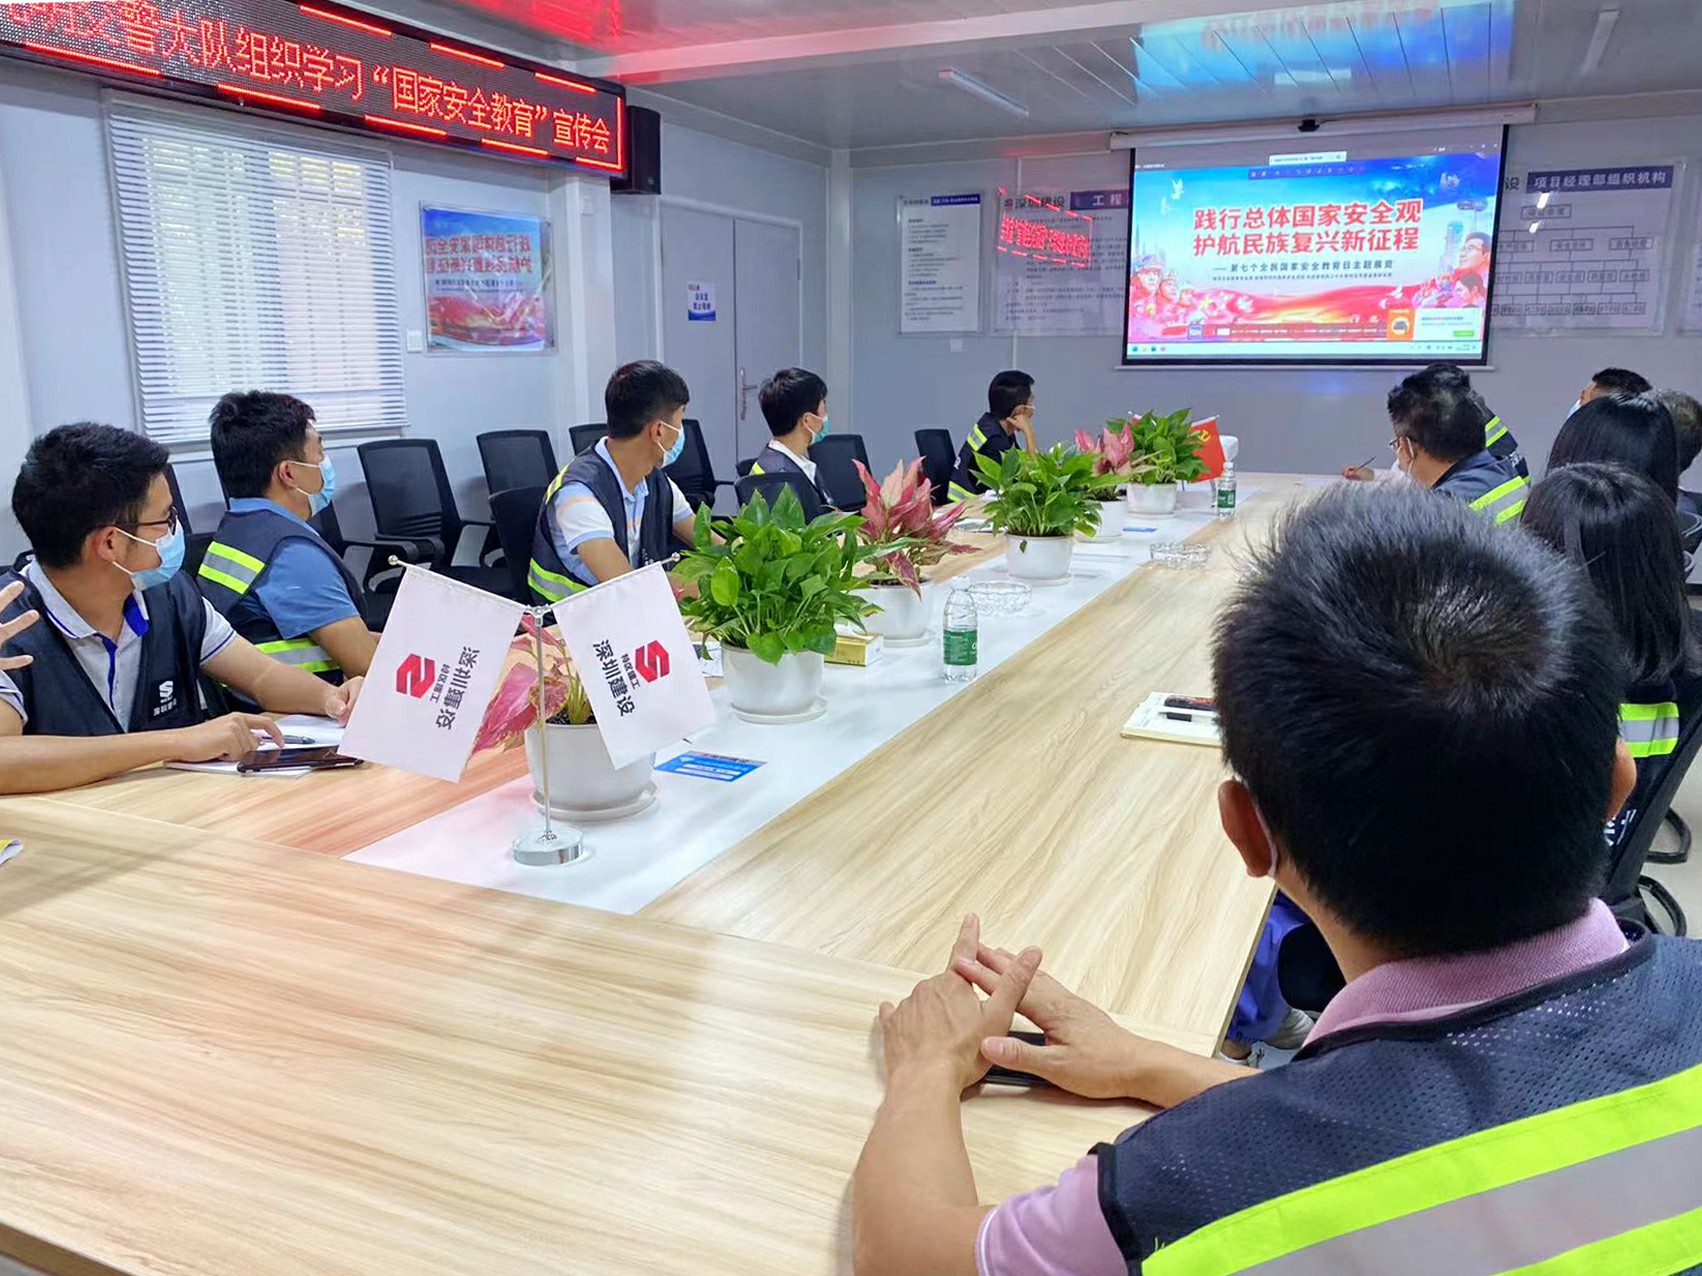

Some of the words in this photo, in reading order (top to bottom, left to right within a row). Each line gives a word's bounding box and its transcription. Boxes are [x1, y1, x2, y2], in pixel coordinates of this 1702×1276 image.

[1534, 171, 1666, 188] 项目经理部组织机构
[1194, 200, 1422, 230] 践行总体国家安全观
[1193, 227, 1420, 256] 护航民族复兴新征程
[593, 639, 635, 717] 深圳建设
